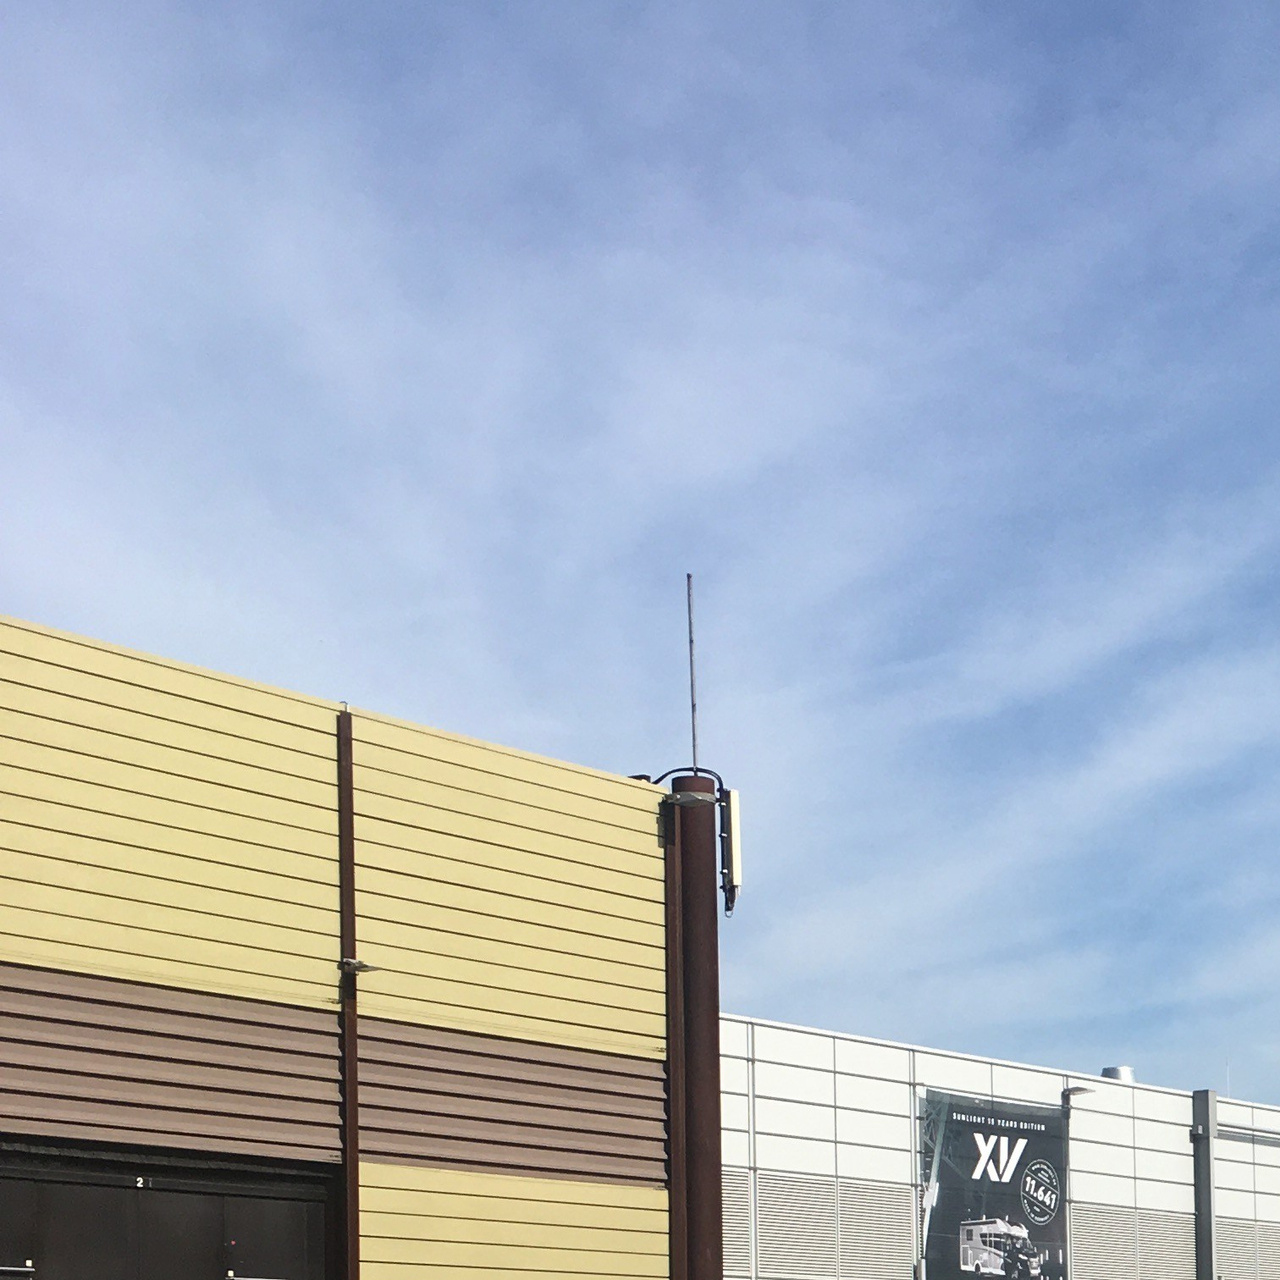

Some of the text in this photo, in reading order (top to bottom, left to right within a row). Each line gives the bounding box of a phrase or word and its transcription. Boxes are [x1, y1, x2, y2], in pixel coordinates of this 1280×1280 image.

[971, 1132, 1028, 1183] XV
[136, 1176, 144, 1188] 2
[1025, 1176, 1056, 1209] 11.641
